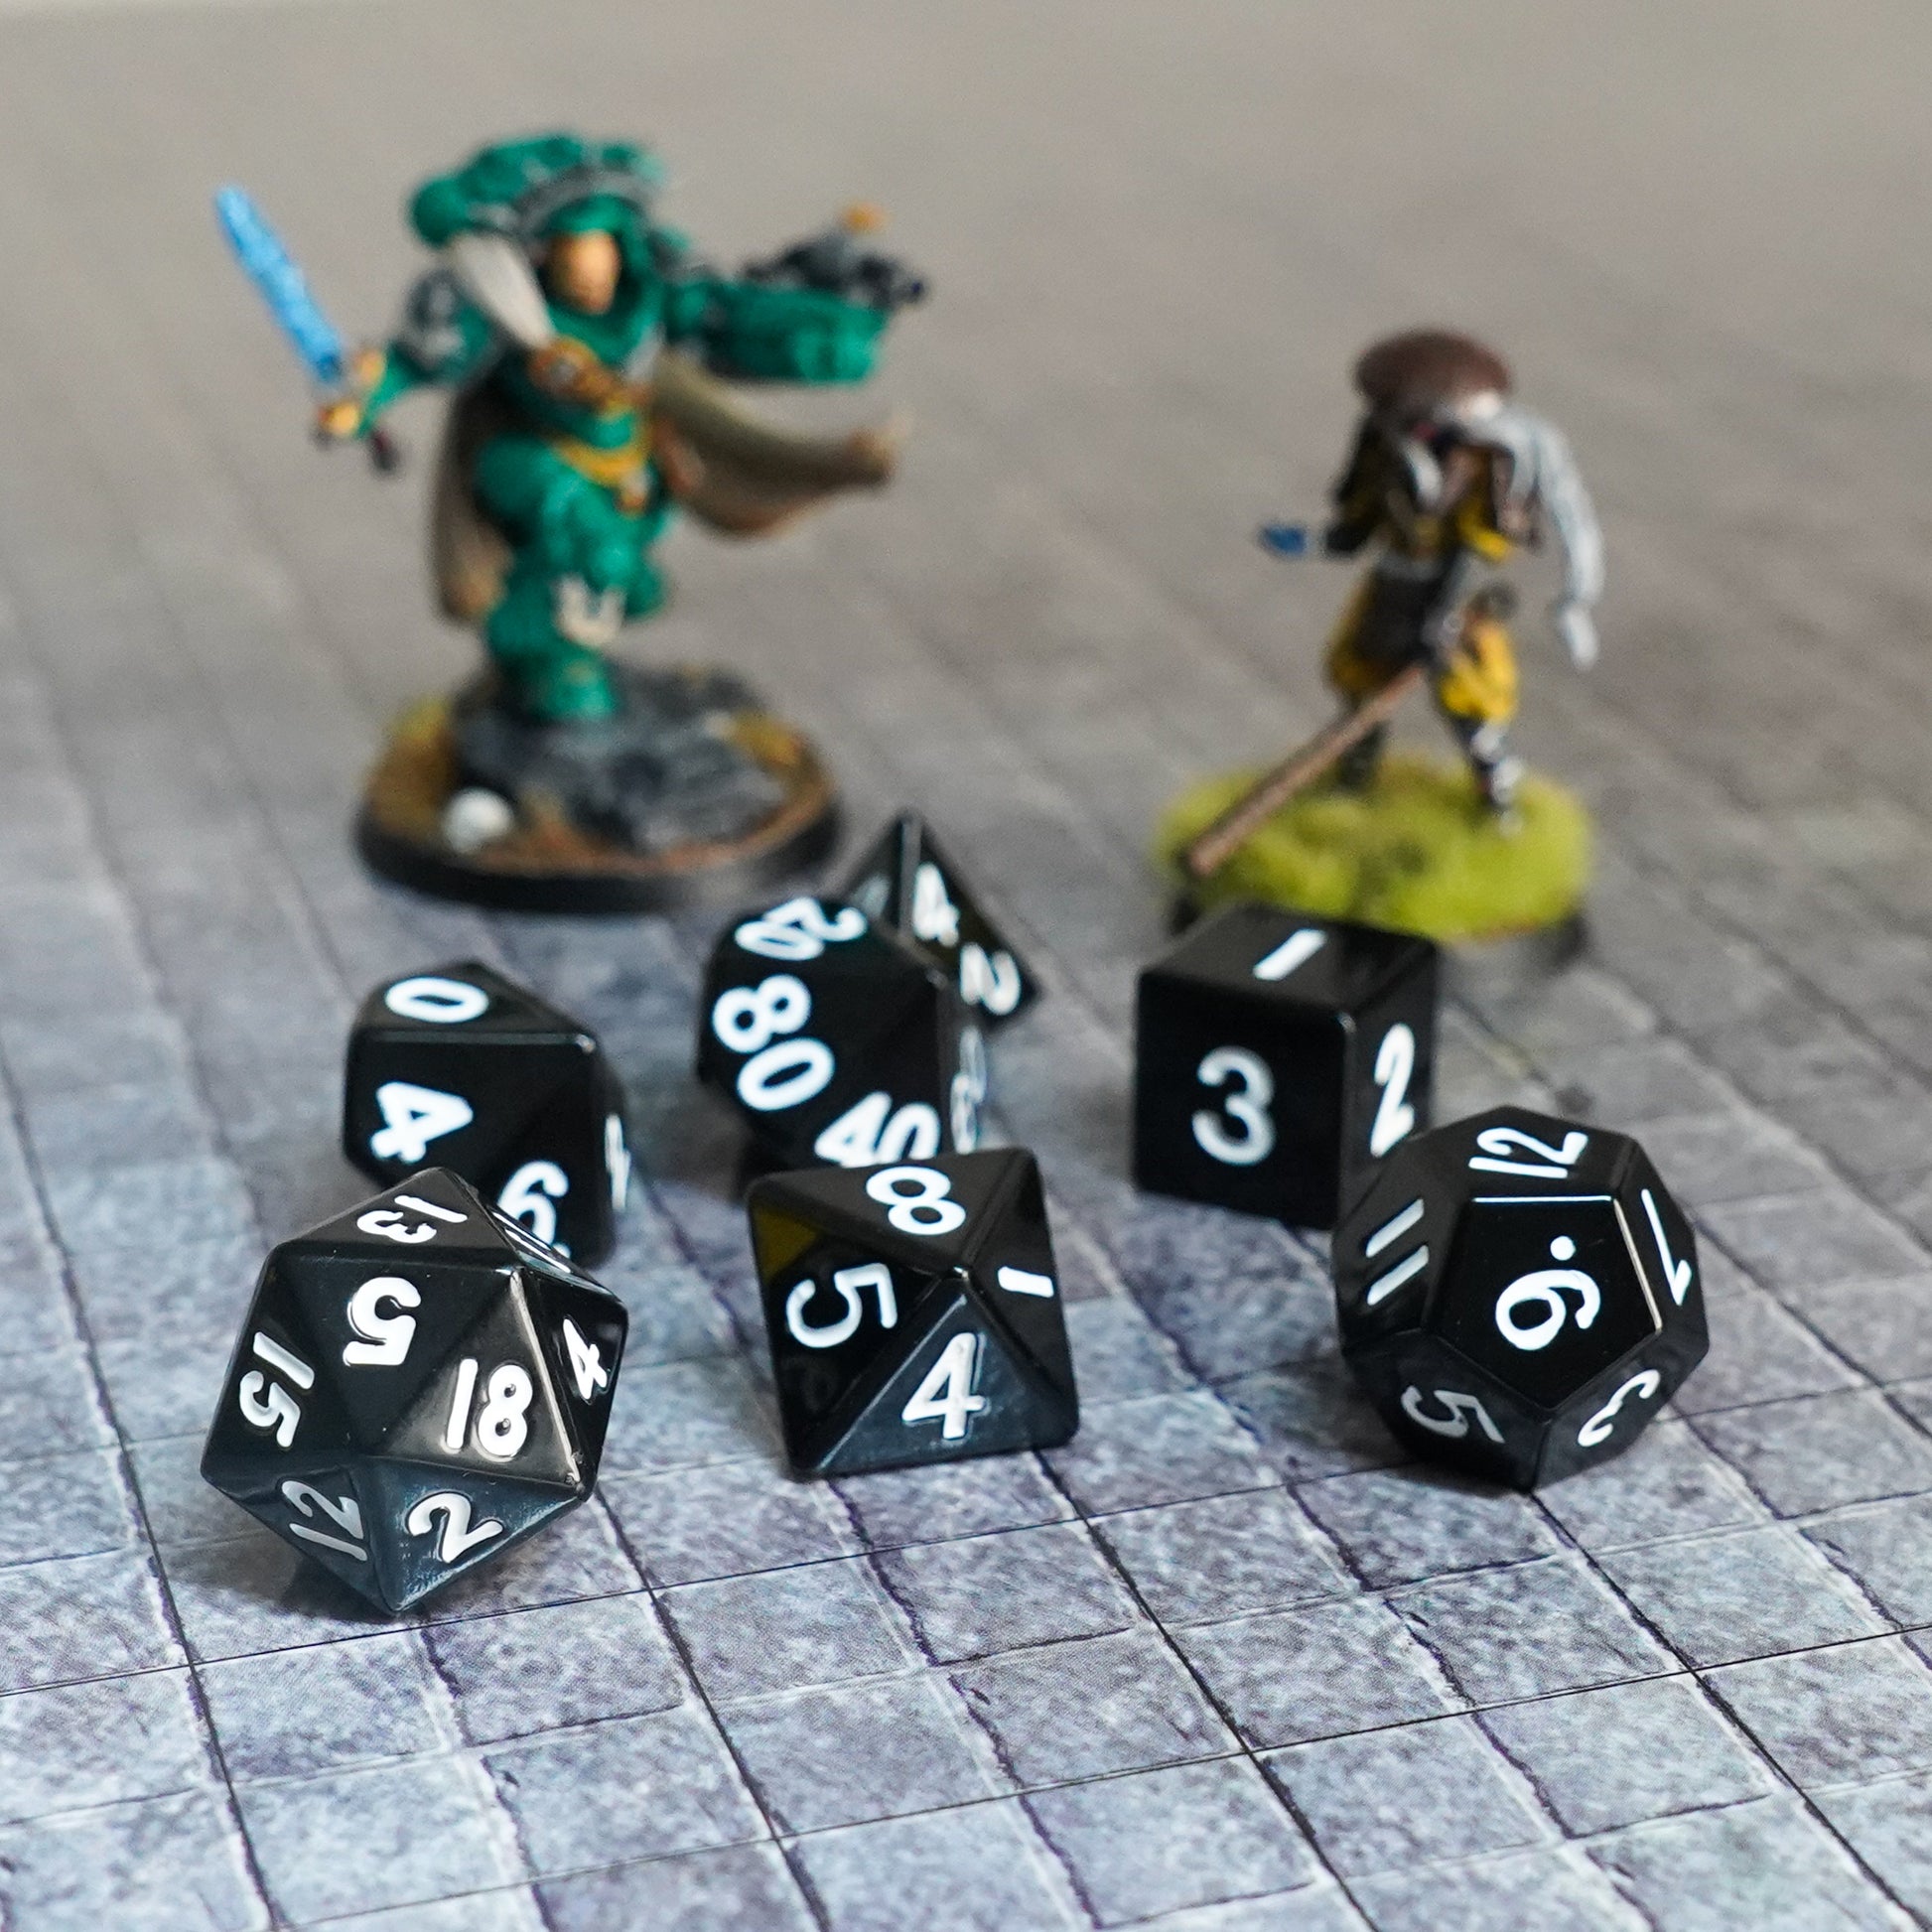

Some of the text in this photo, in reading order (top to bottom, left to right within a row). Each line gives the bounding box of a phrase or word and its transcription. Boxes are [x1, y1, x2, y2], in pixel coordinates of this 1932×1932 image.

[736, 896, 865, 960] 20
[912, 866, 958, 944] 4
[1255, 930, 1323, 980] 1
[385, 978, 488, 1023] 0
[713, 976, 833, 1110] 80
[371, 1082, 473, 1162] 4
[1192, 1046, 1275, 1165] 3
[1371, 1025, 1414, 1156] 2
[1468, 1128, 1587, 1178] 12
[356, 1195, 468, 1243] 13
[867, 1167, 966, 1235] 8
[998, 1267, 1053, 1298] 1
[1366, 1199, 1429, 1306] 11
[343, 1277, 421, 1366] 5
[786, 1263, 897, 1347] 5
[239, 1332, 314, 1447] 15
[563, 1319, 607, 1400] 4
[902, 1333, 984, 1439] 4
[444, 1358, 532, 1459] 18
[1402, 1387, 1503, 1443] 5
[1578, 1369, 1661, 1447] 3
[282, 1481, 367, 1561] 12
[409, 1493, 502, 1563] 2
